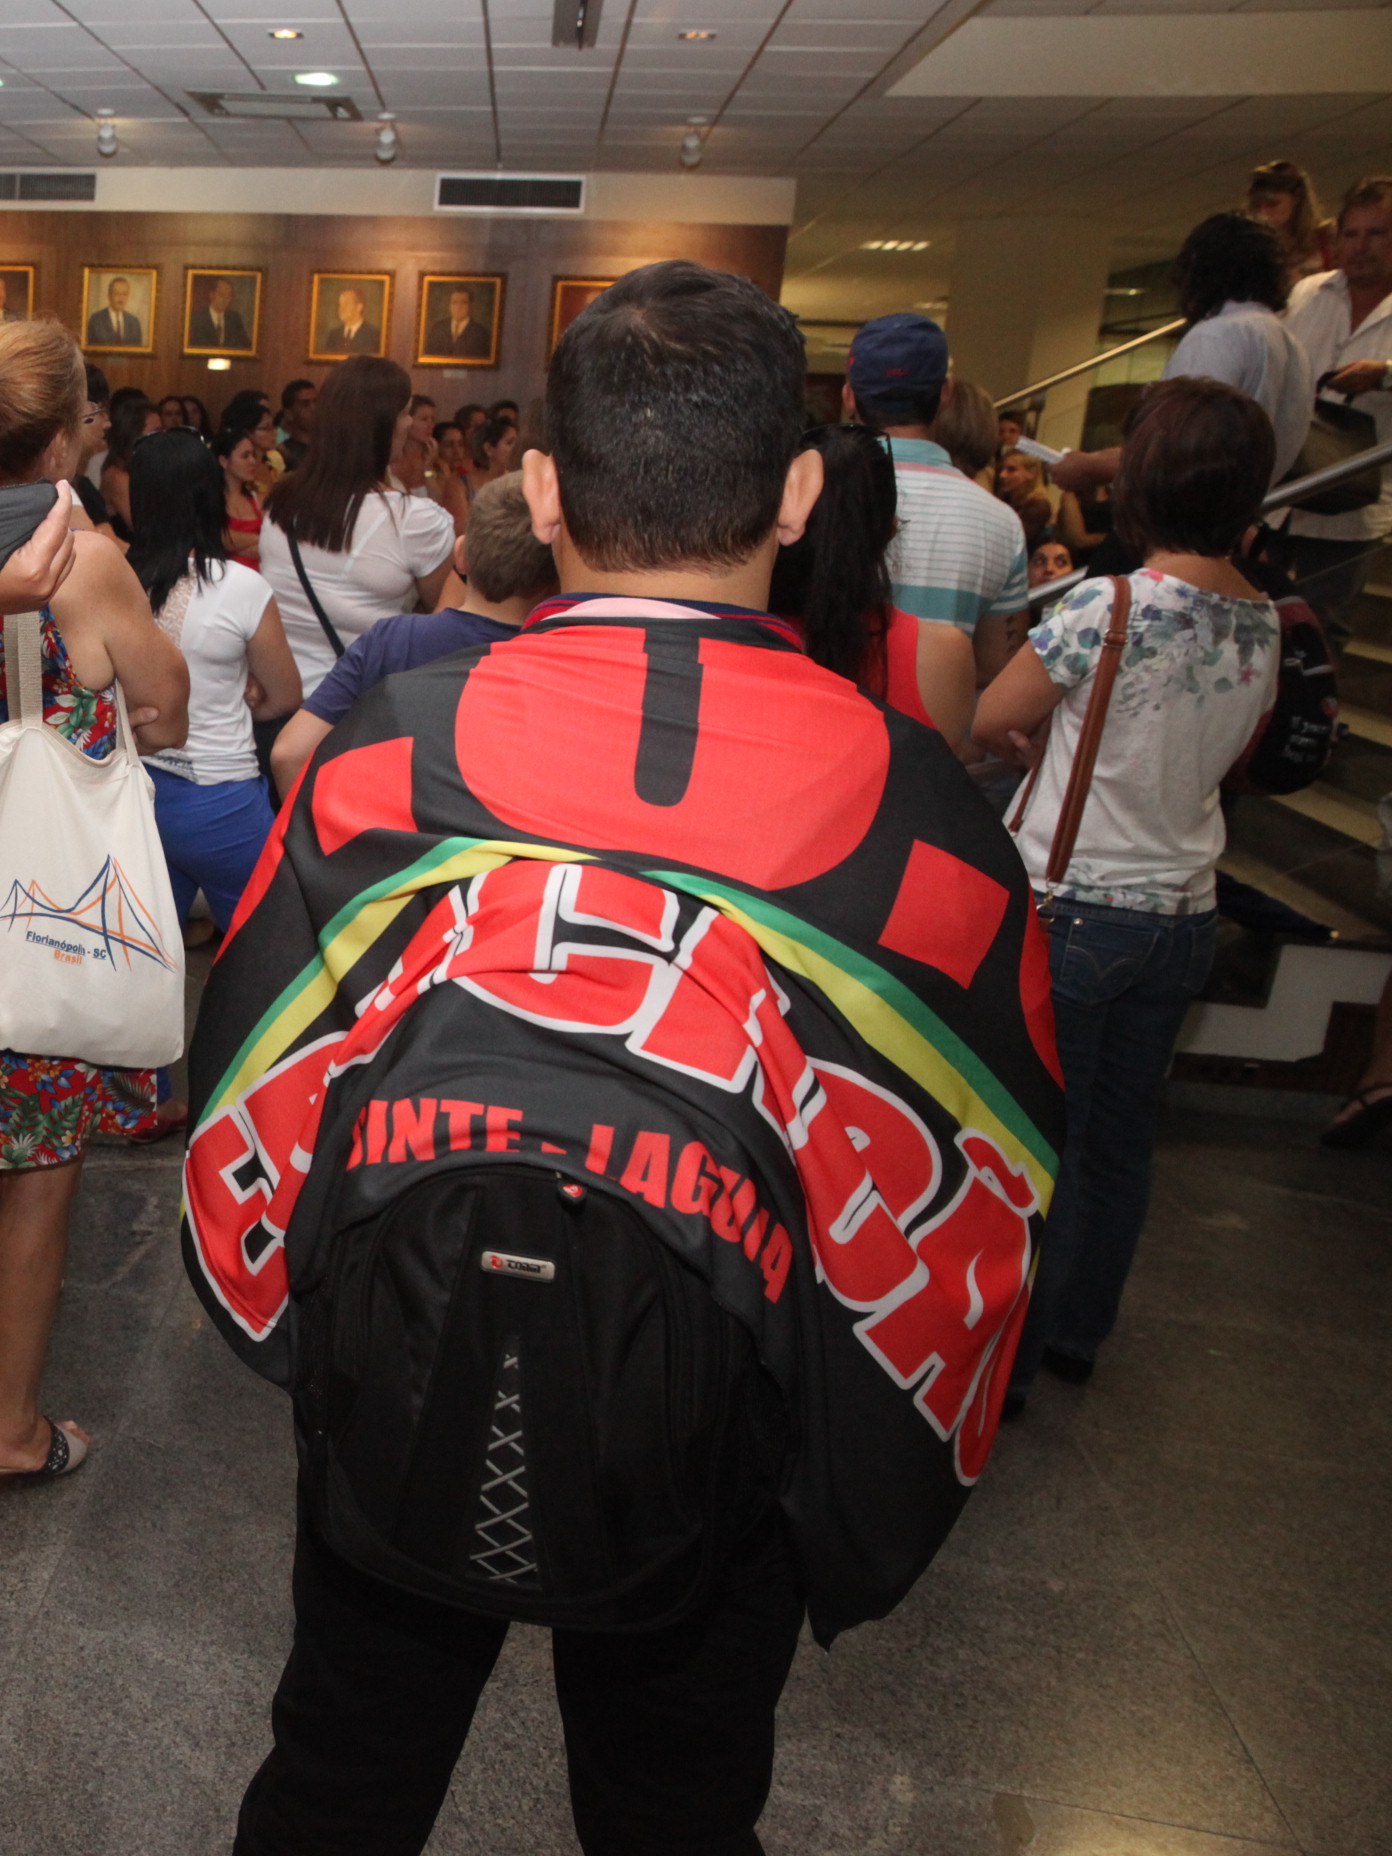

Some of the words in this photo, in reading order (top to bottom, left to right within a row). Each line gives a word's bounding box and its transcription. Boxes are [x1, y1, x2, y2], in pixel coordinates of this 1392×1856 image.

[25, 931, 86, 955] Florianópolis
[93, 948, 107, 960] SC
[53, 949, 83, 965] Brasil
